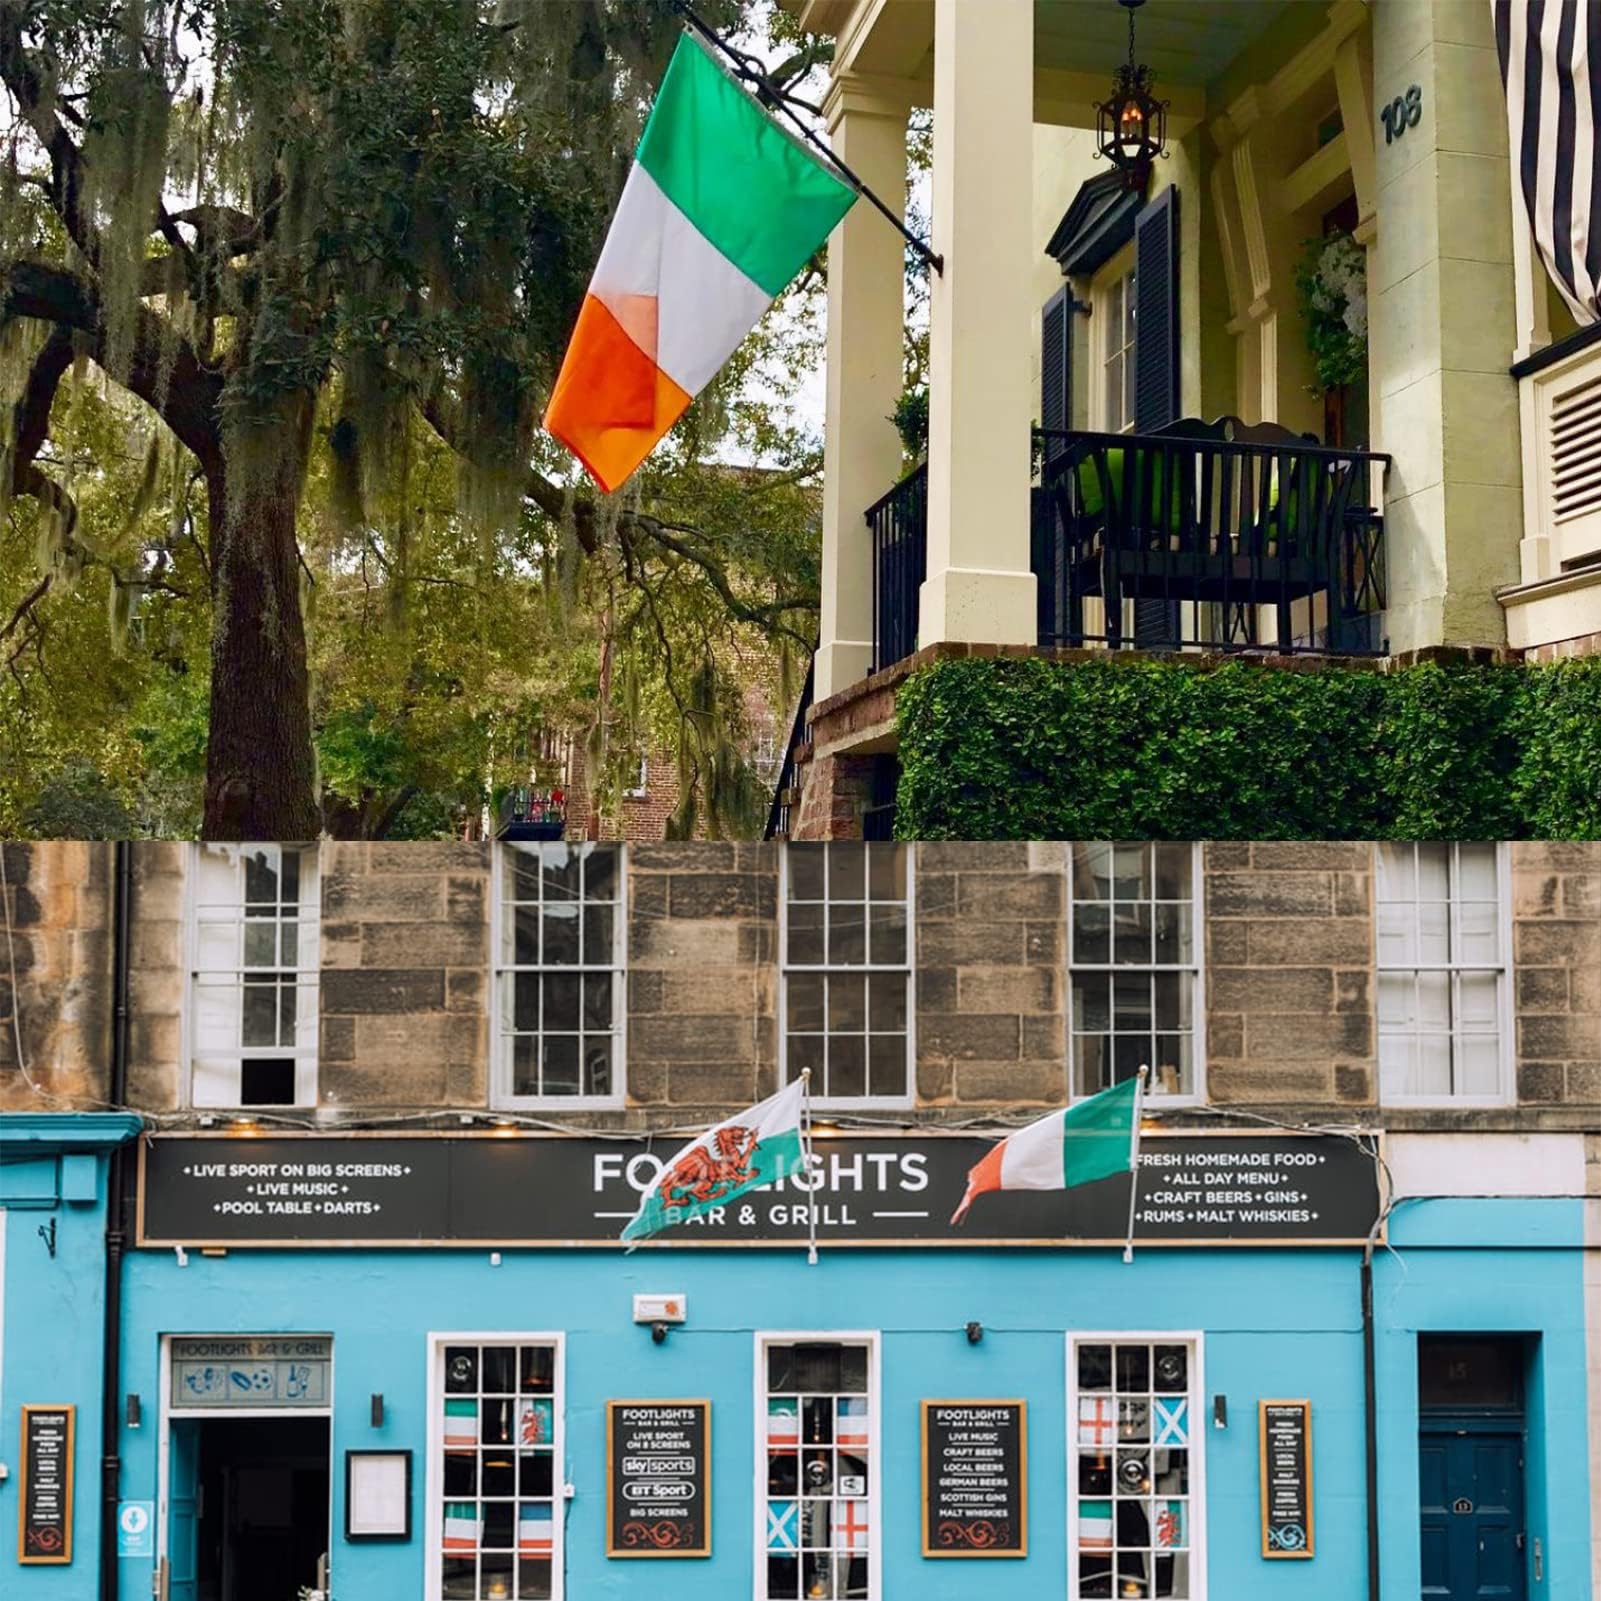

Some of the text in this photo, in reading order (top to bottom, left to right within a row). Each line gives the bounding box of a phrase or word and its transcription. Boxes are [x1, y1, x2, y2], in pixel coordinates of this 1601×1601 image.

[1381, 85, 1422, 144] 108
[1185, 1154, 1270, 1166] HOMEMADE
[1274, 1154, 1316, 1165] FOOD
[194, 1164, 402, 1176] LIVE SPORT ON BIG SCREENS
[1173, 1173, 1279, 1184] ALL DAY MENU
[257, 1183, 338, 1195] LIVE MUSIC
[1153, 1191, 1299, 1203] CRAFT BEERS GINS
[220, 1202, 372, 1214] POOL TABLE DARTS
[738, 1205, 756, 1225] &
[769, 1205, 856, 1225] GRILL
[1144, 1210, 1309, 1222] RUMS MALT WHISKIES
[623, 1409, 695, 1420] FOOTLIGHTS
[937, 1410, 1010, 1420] FOOTLIGHTS
[633, 1432, 683, 1440] LIVE SPORT
[949, 1433, 998, 1441] LIVE MUSIC
[627, 1441, 640, 1449] ON
[651, 1441, 691, 1449] SCREENS
[944, 1448, 1004, 1456] CRAFT BEERS
[627, 1459, 691, 1471] sky sports
[944, 1464, 1004, 1472] LOCAL BEERS
[653, 1484, 686, 1497] Sport
[941, 1494, 984, 1502] SCOTTISH
[940, 1509, 962, 1517] MALT
